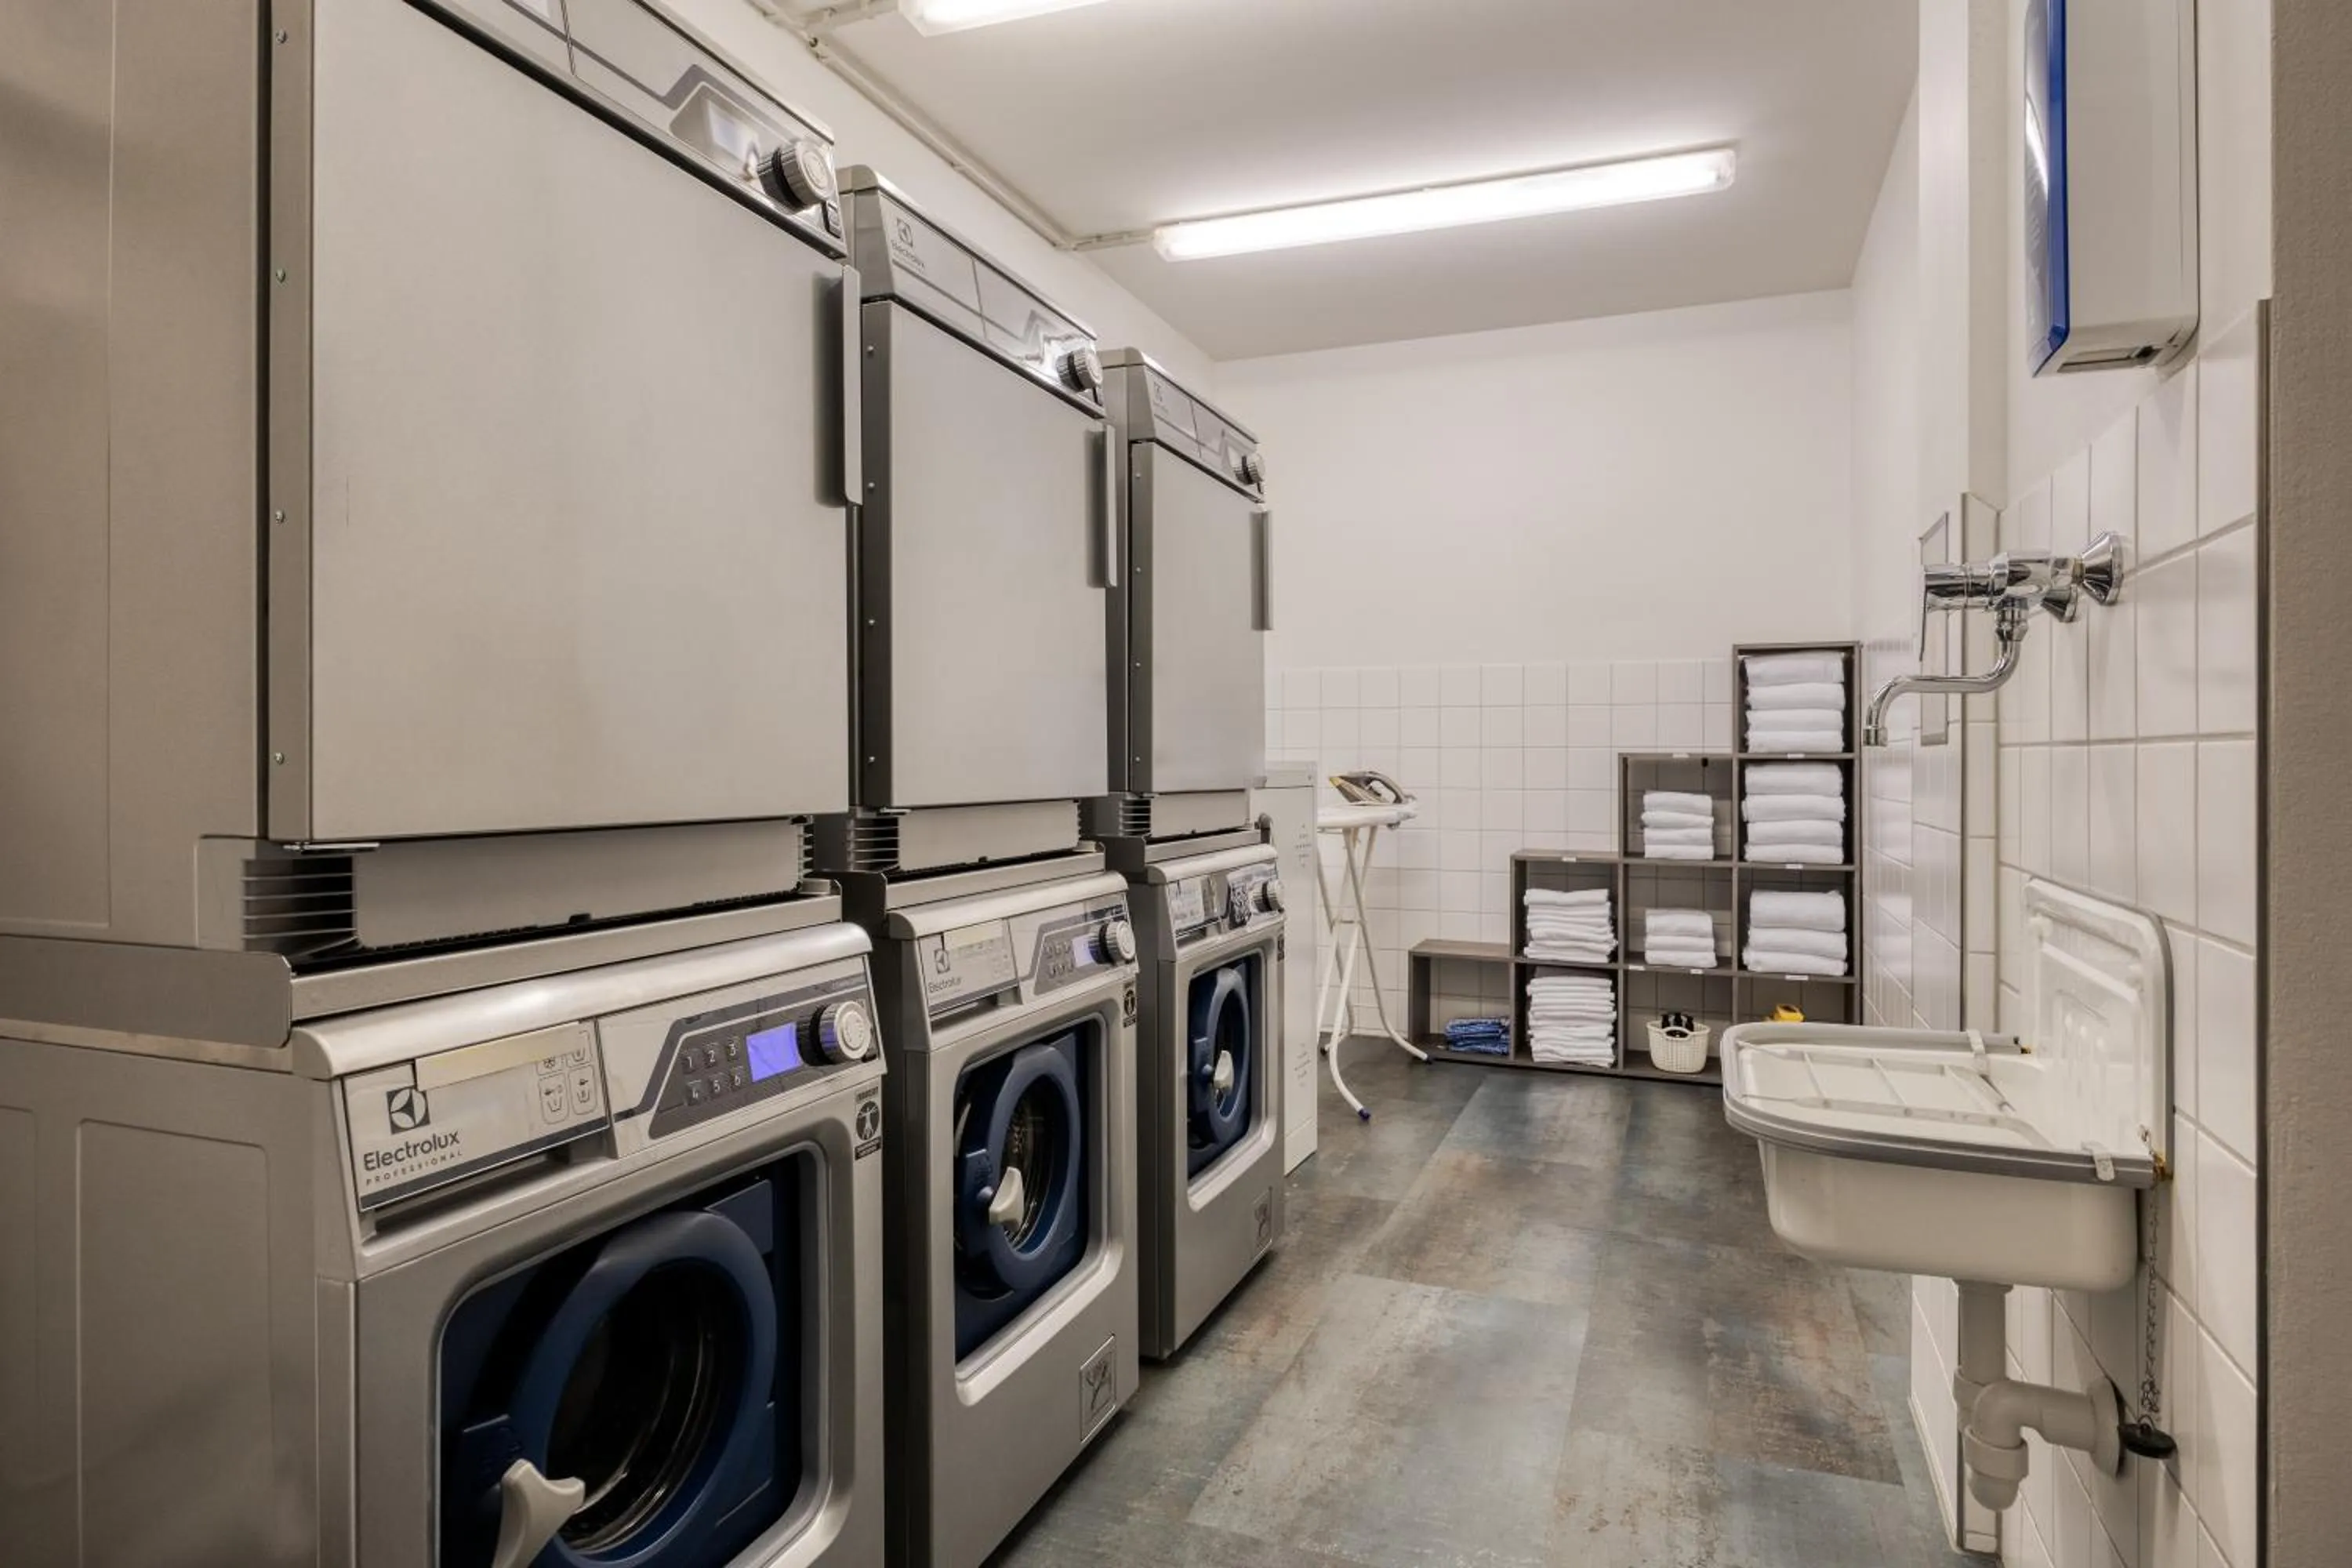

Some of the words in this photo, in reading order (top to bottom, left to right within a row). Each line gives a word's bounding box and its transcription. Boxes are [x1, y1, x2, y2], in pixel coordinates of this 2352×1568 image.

[686, 1056, 692, 1069] 1
[708, 1049, 716, 1063] 2
[728, 1043, 736, 1057] 3
[713, 1080, 720, 1094] 5
[363, 1131, 460, 1171] Electrolux
[365, 1150, 463, 1187] PROFESSIONAL
